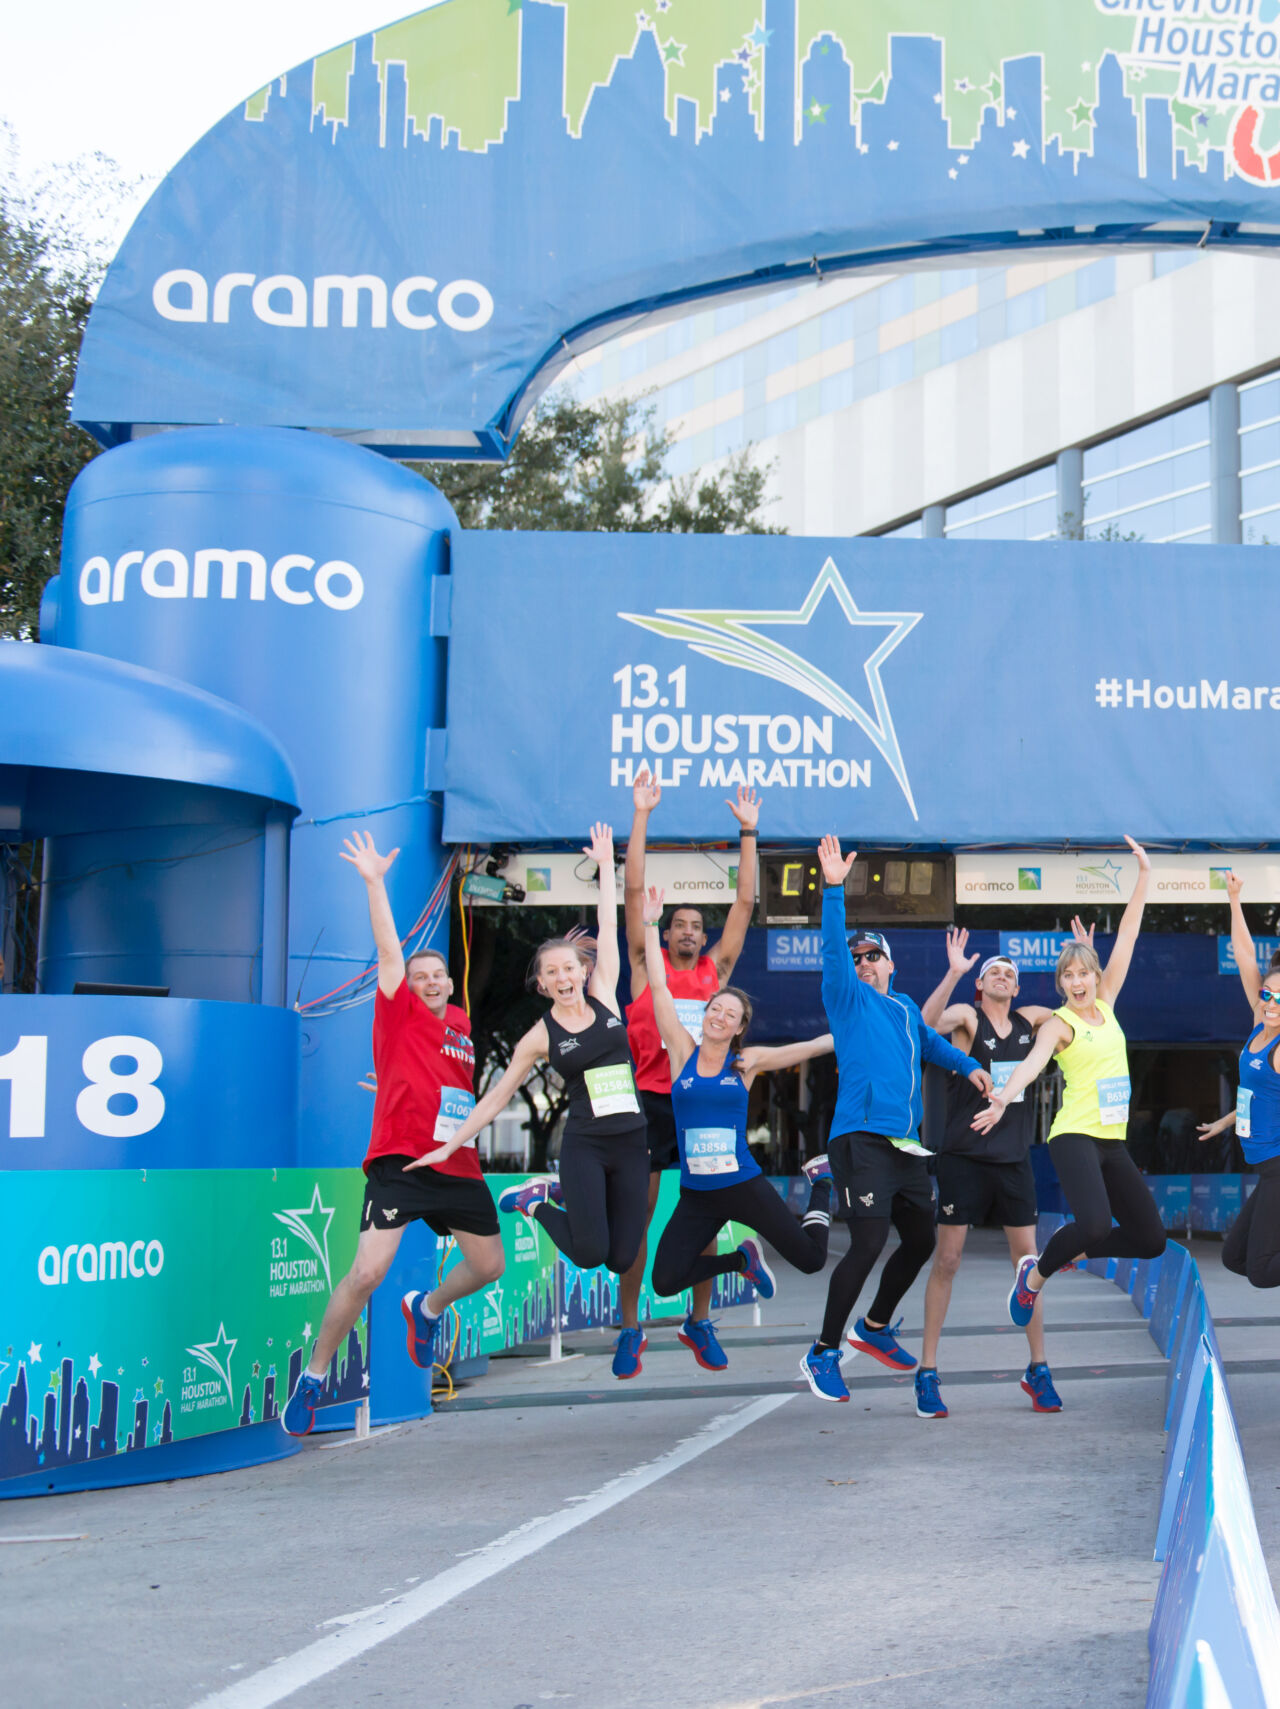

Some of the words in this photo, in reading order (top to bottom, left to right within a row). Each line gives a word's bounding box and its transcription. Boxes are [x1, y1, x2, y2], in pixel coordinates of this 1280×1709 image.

[152, 268, 495, 333] aramco
[79, 548, 365, 611] aramco
[612, 663, 687, 709] 13.1
[611, 713, 834, 755] HOUSTON
[610, 757, 693, 788] HALF
[700, 758, 872, 788] MARATHON
[673, 879, 725, 891] aramco
[965, 881, 1015, 892] aramco
[1157, 880, 1206, 891] aramco
[270, 1236, 288, 1259] 13.1
[37, 1238, 165, 1286] aramco
[269, 1258, 318, 1281] HOUSTON
[269, 1283, 288, 1298] HALF
[289, 1279, 326, 1297] MARATHON
[181, 1379, 222, 1401] HOUSTON
